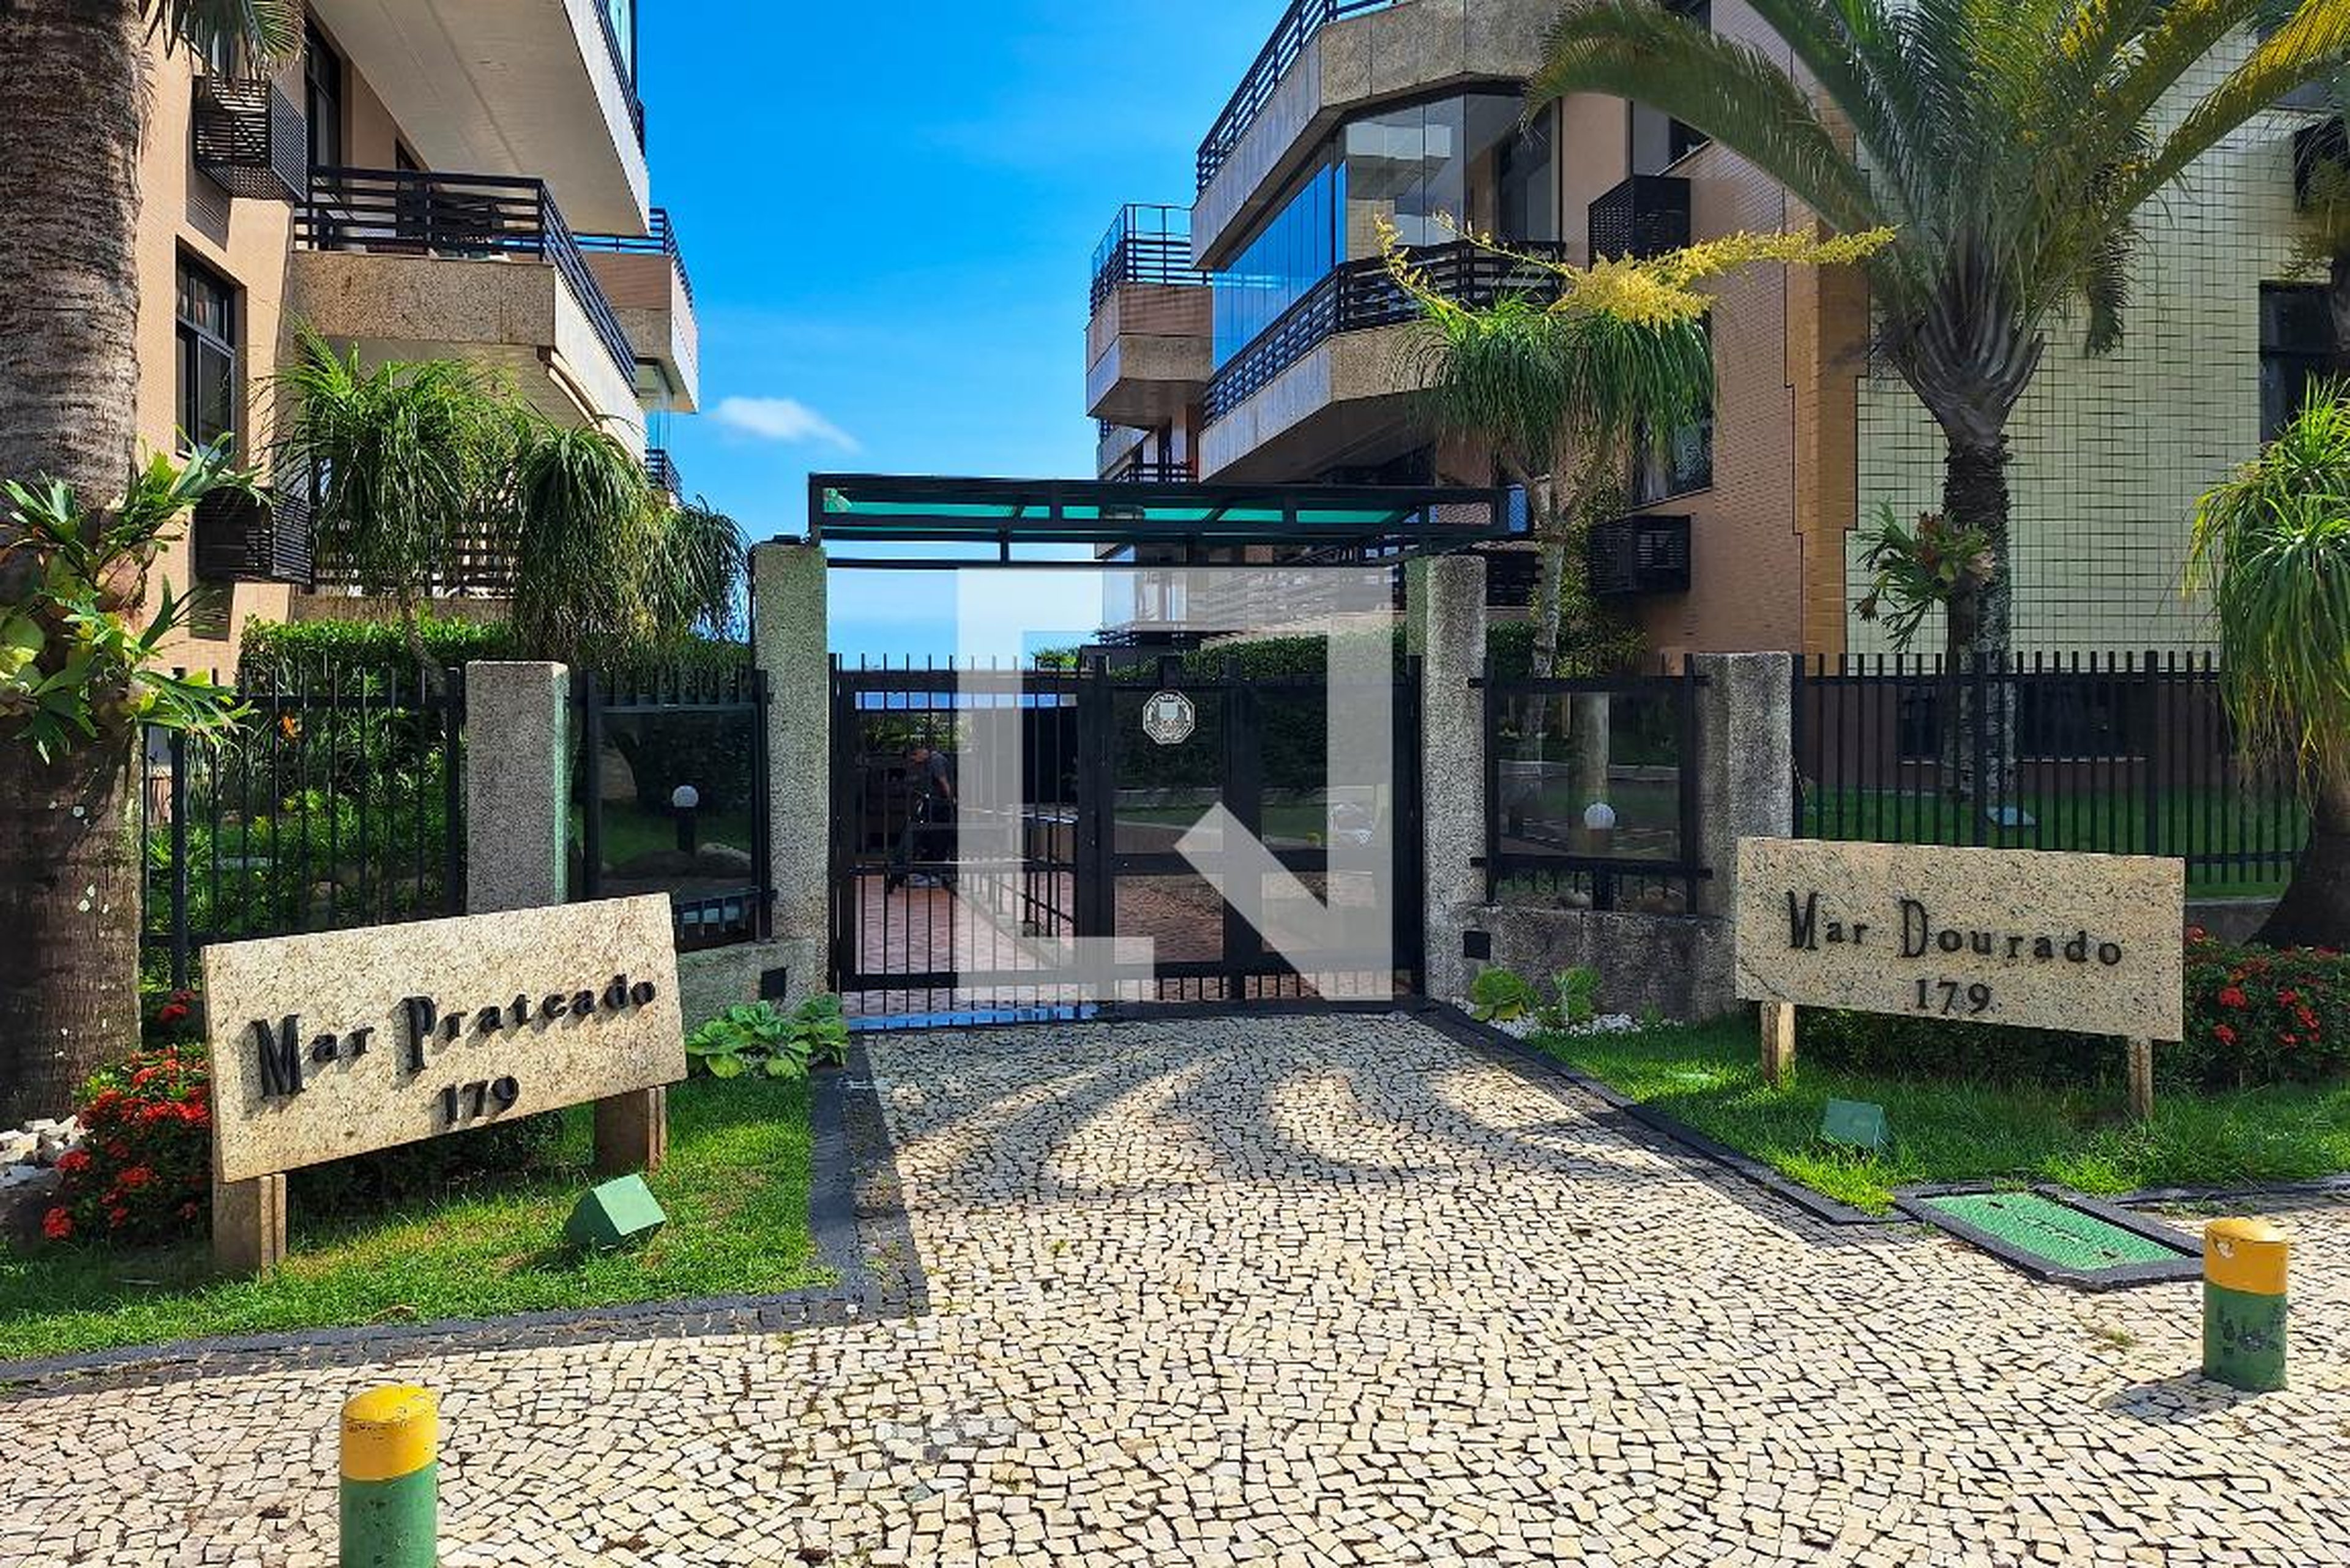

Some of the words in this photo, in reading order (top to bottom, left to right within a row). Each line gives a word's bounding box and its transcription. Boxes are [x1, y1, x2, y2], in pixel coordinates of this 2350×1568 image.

[1785, 888, 1869, 950] Mar
[1899, 899, 2122, 966] Dourado
[1915, 977, 1991, 1015] 179
[249, 1014, 375, 1099] Mar
[436, 1075, 519, 1124] 179
